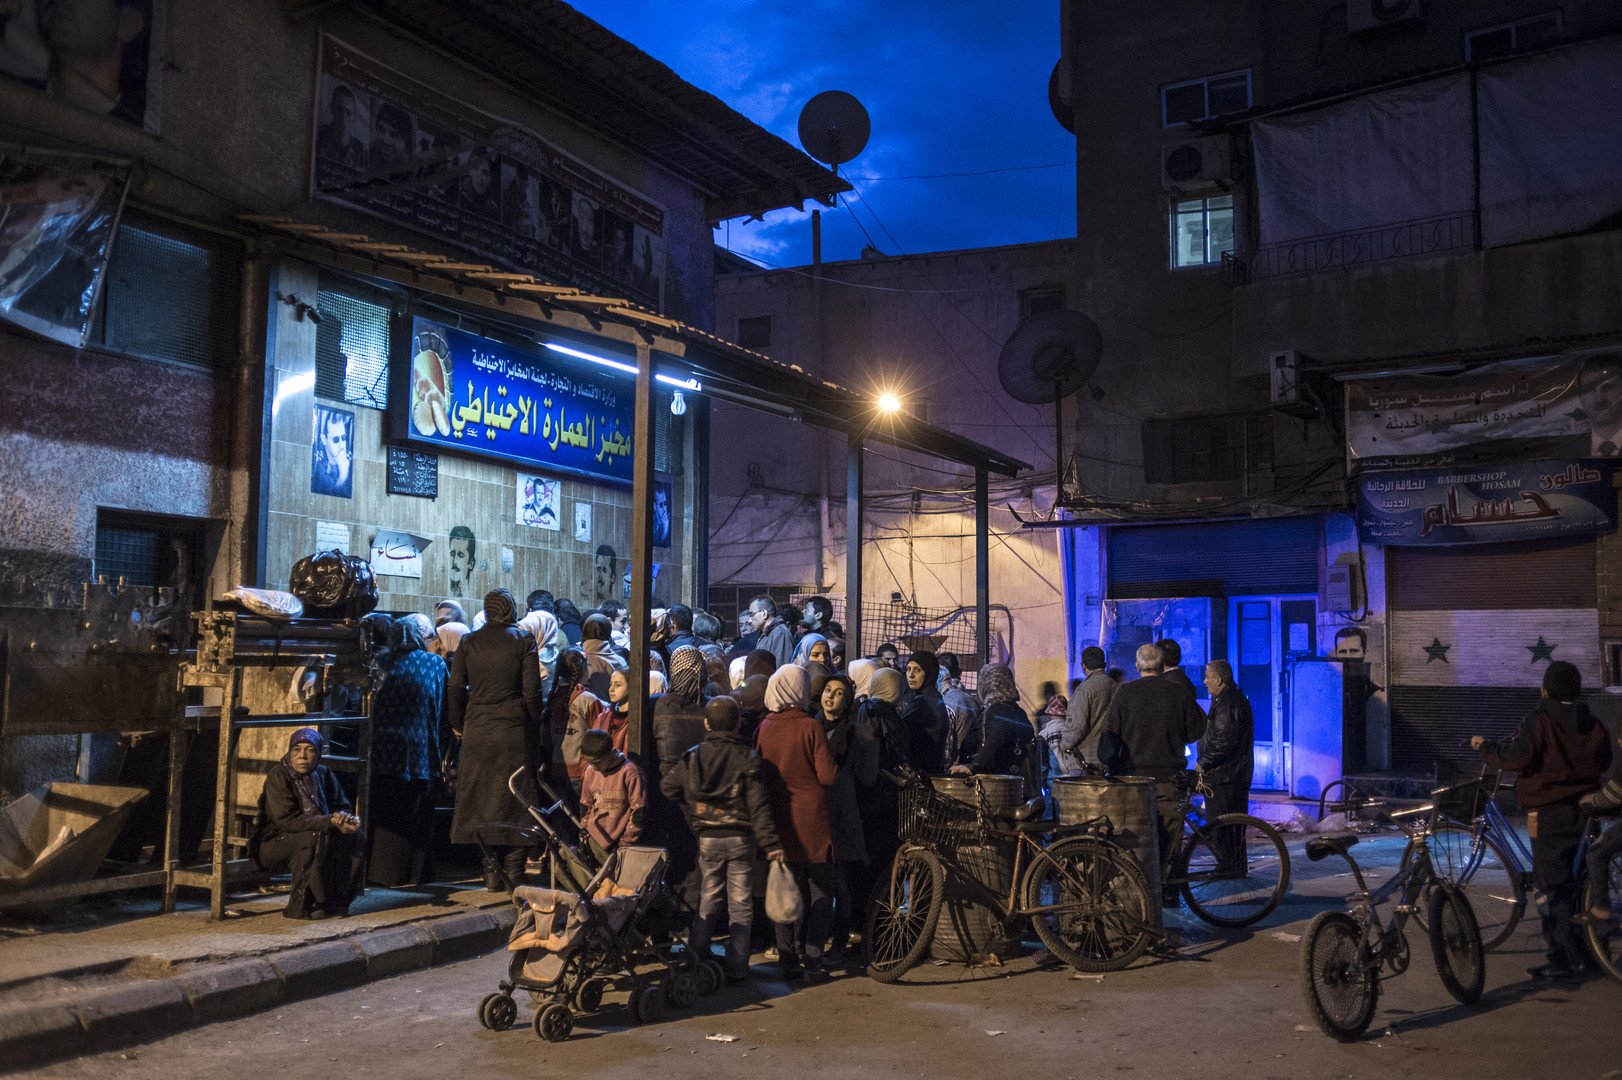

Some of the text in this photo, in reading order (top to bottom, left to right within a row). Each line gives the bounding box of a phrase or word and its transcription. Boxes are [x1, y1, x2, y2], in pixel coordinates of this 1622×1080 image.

[472, 348, 506, 373] الاحتياطية
[506, 357, 530, 380] المخابز
[530, 364, 547, 387] لجنة
[551, 374, 572, 394] التجارة
[577, 379, 601, 401] الاقتصاد
[601, 386, 616, 408] وزارة
[1412, 391, 1477, 408] مستقبل
[1369, 395, 1408, 411] سوريا
[451, 379, 631, 467] مخبز العمارة الاحتياطي
[1367, 479, 1426, 494] للحلاقة الرجالية
[1437, 471, 1507, 485] BARBERSHOP
[1481, 479, 1521, 491] HOSAM
[1539, 464, 1602, 491] صالون
[1420, 484, 1563, 539] حسام
